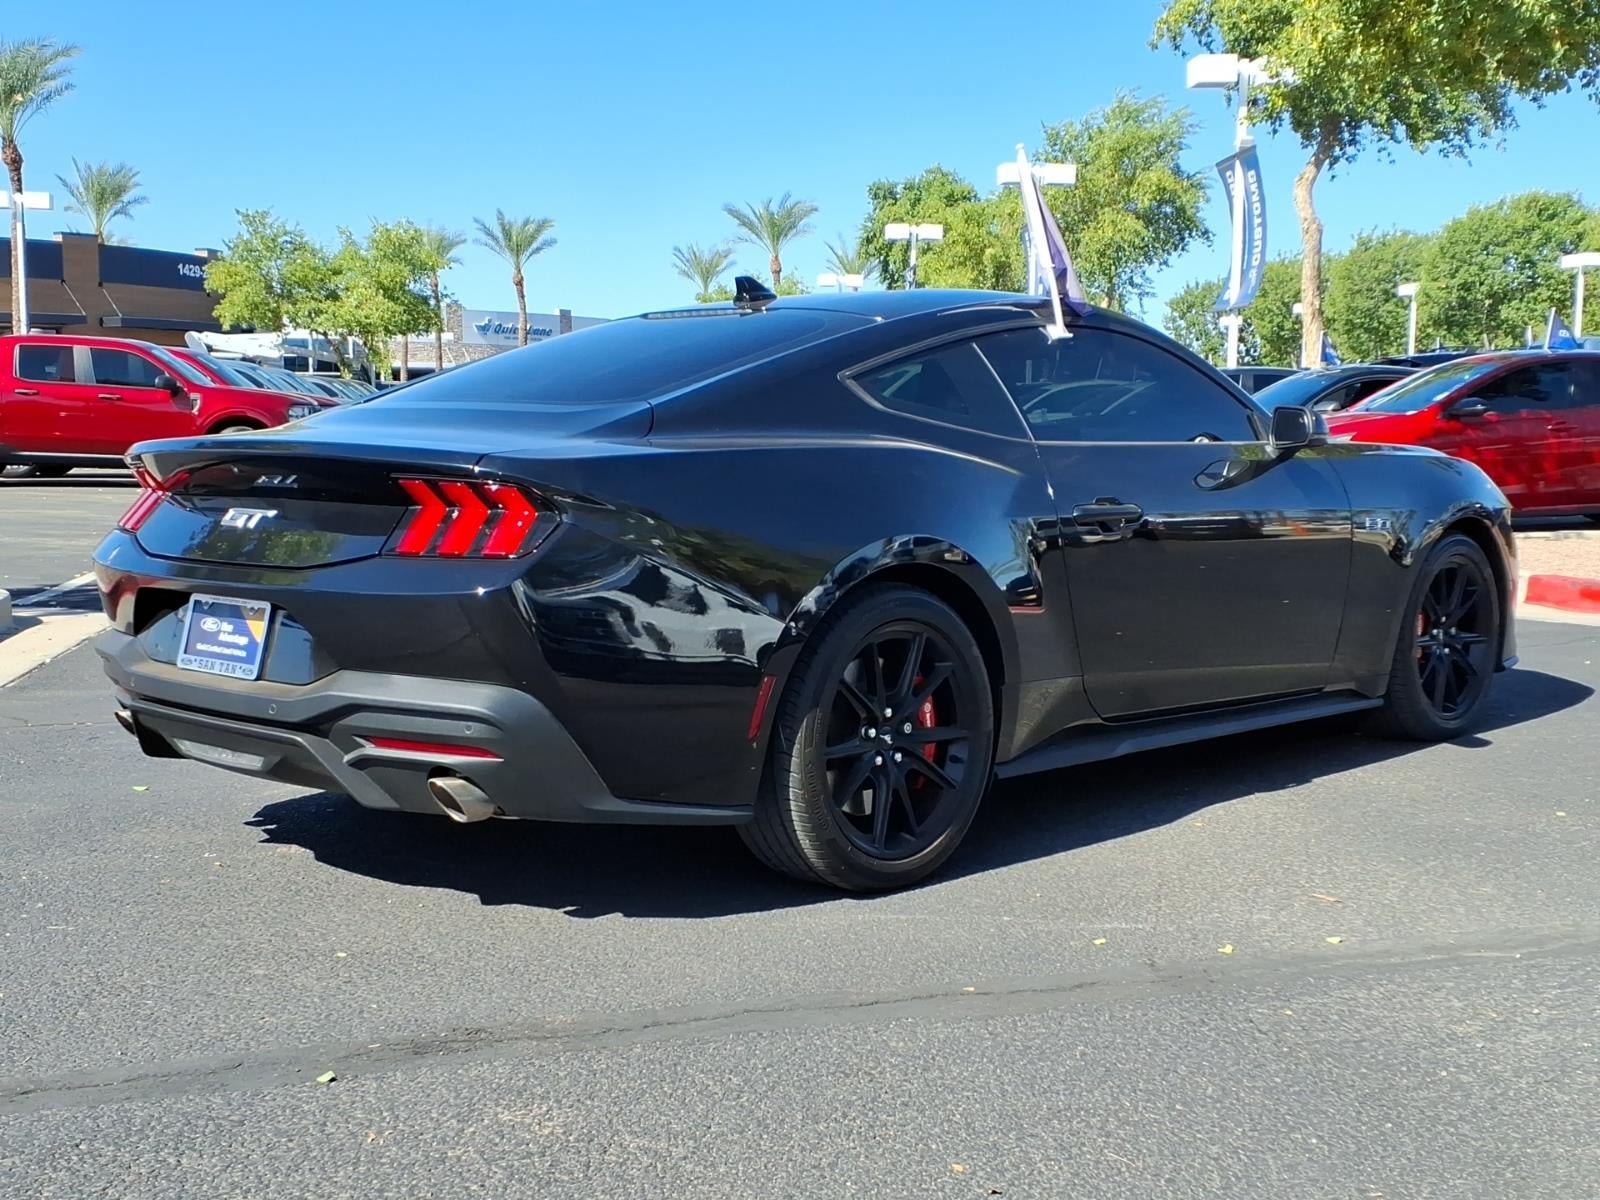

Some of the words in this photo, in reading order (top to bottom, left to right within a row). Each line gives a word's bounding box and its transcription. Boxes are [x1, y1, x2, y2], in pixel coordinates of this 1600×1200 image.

[494, 323, 523, 334] Quic
[527, 325, 553, 336] Lane
[220, 507, 278, 529] GT
[198, 658, 215, 671] SAN
[219, 660, 237, 674] TAN
